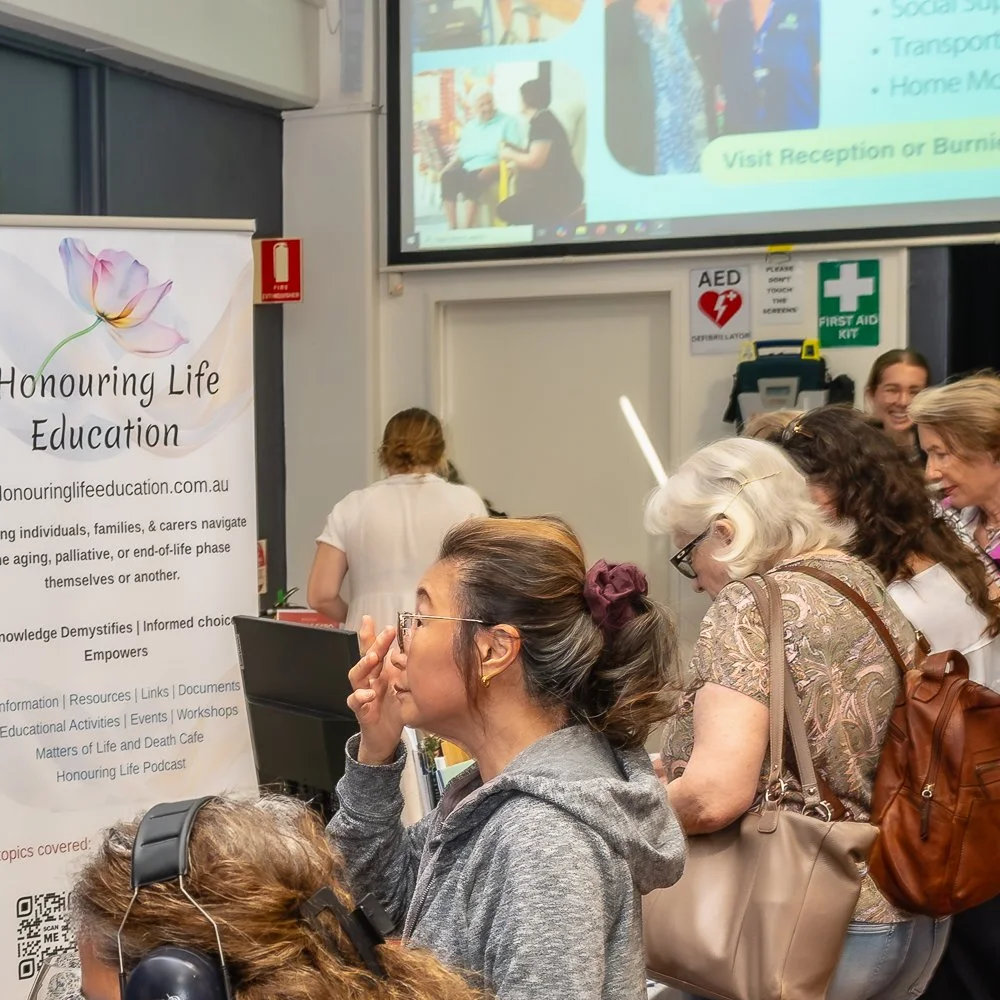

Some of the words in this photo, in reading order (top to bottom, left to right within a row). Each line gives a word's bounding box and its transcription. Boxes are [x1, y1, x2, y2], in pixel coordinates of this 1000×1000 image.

[890, 75, 962, 97] Home
[722, 150, 772, 169] Visit
[780, 142, 895, 166] Reception
[902, 143, 924, 158] or
[933, 131, 1000, 155] Burni
[698, 269, 741, 288] AED
[819, 315, 852, 327] FIRST
[856, 314, 878, 326] AID
[692, 332, 750, 343] DEFIBRILLATOR
[838, 328, 859, 340] KIT
[168, 360, 220, 398] Life
[31, 413, 179, 450] Education
[19, 524, 90, 539] individuals,
[94, 520, 145, 536] families,
[148, 521, 157, 532] &
[159, 519, 197, 531] carers
[201, 516, 247, 531] navigate
[13, 552, 52, 568] aging,
[55, 547, 114, 566] palliative,
[118, 547, 130, 559] or
[133, 543, 192, 559] end-of-life
[196, 542, 231, 557] phase
[44, 573, 114, 589] themselves
[118, 572, 131, 584] or
[134, 570, 180, 583] another.
[61, 621, 132, 641] Demystifies
[143, 616, 194, 632] Informed
[198, 614, 233, 628] choic
[84, 647, 148, 662] Empowers
[70, 692, 131, 706] Resources
[141, 686, 169, 699] Links
[178, 680, 240, 696] Documents
[0, 720, 66, 738] Educational
[70, 716, 120, 731] Activities
[131, 711, 167, 725] Events
[177, 705, 239, 720] Workshops
[36, 744, 78, 759] Matters
[82, 742, 93, 755] of
[97, 740, 117, 754] Life
[120, 738, 140, 750] and
[145, 734, 176, 748] Death
[179, 732, 204, 744] Cafe
[57, 765, 116, 782] Honouring
[120, 762, 139, 776] Life
[143, 758, 186, 773] Podcast
[38, 838, 92, 856] covered:
[44, 933, 59, 943] ME
